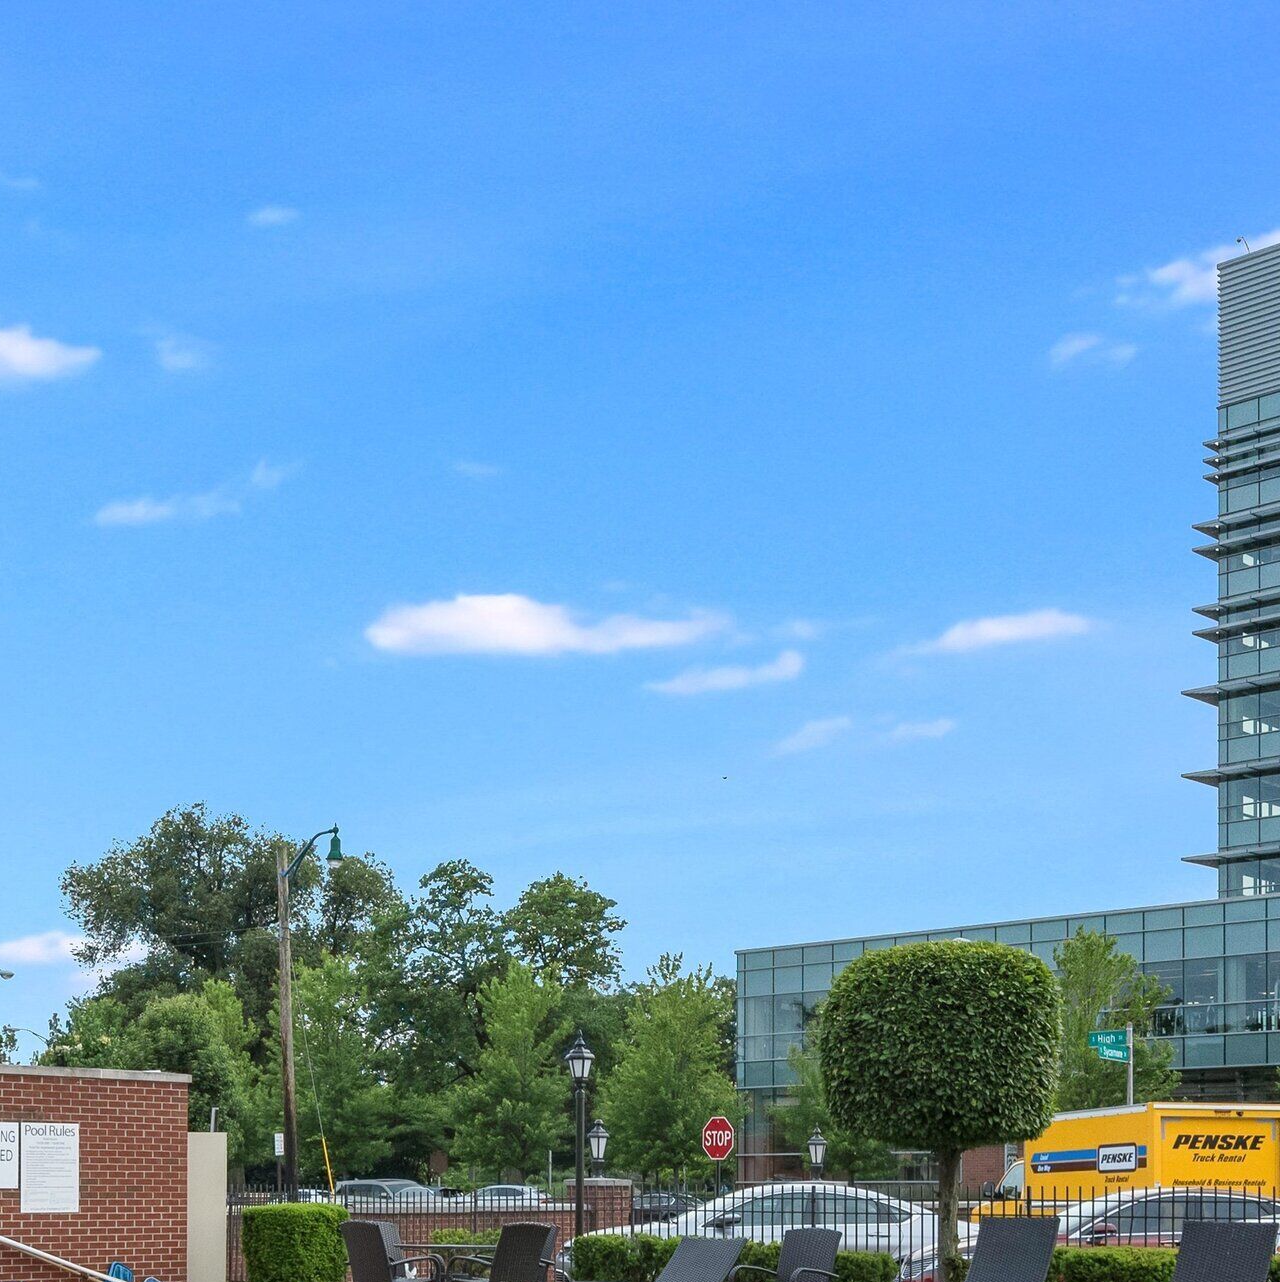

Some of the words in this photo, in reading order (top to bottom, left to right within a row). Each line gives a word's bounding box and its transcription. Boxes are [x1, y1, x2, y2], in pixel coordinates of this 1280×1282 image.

[1097, 1034, 1116, 1044] High
[24, 1124, 47, 1136] Pool
[49, 1125, 76, 1137] Rules
[705, 1130, 731, 1146] STOP
[1172, 1134, 1265, 1150] PENSKE
[1101, 1152, 1133, 1164] PENSKE
[1192, 1153, 1216, 1162] Truck
[1218, 1153, 1247, 1163] Rental
[1104, 1175, 1115, 1183] Truck
[1116, 1175, 1130, 1183] Rental
